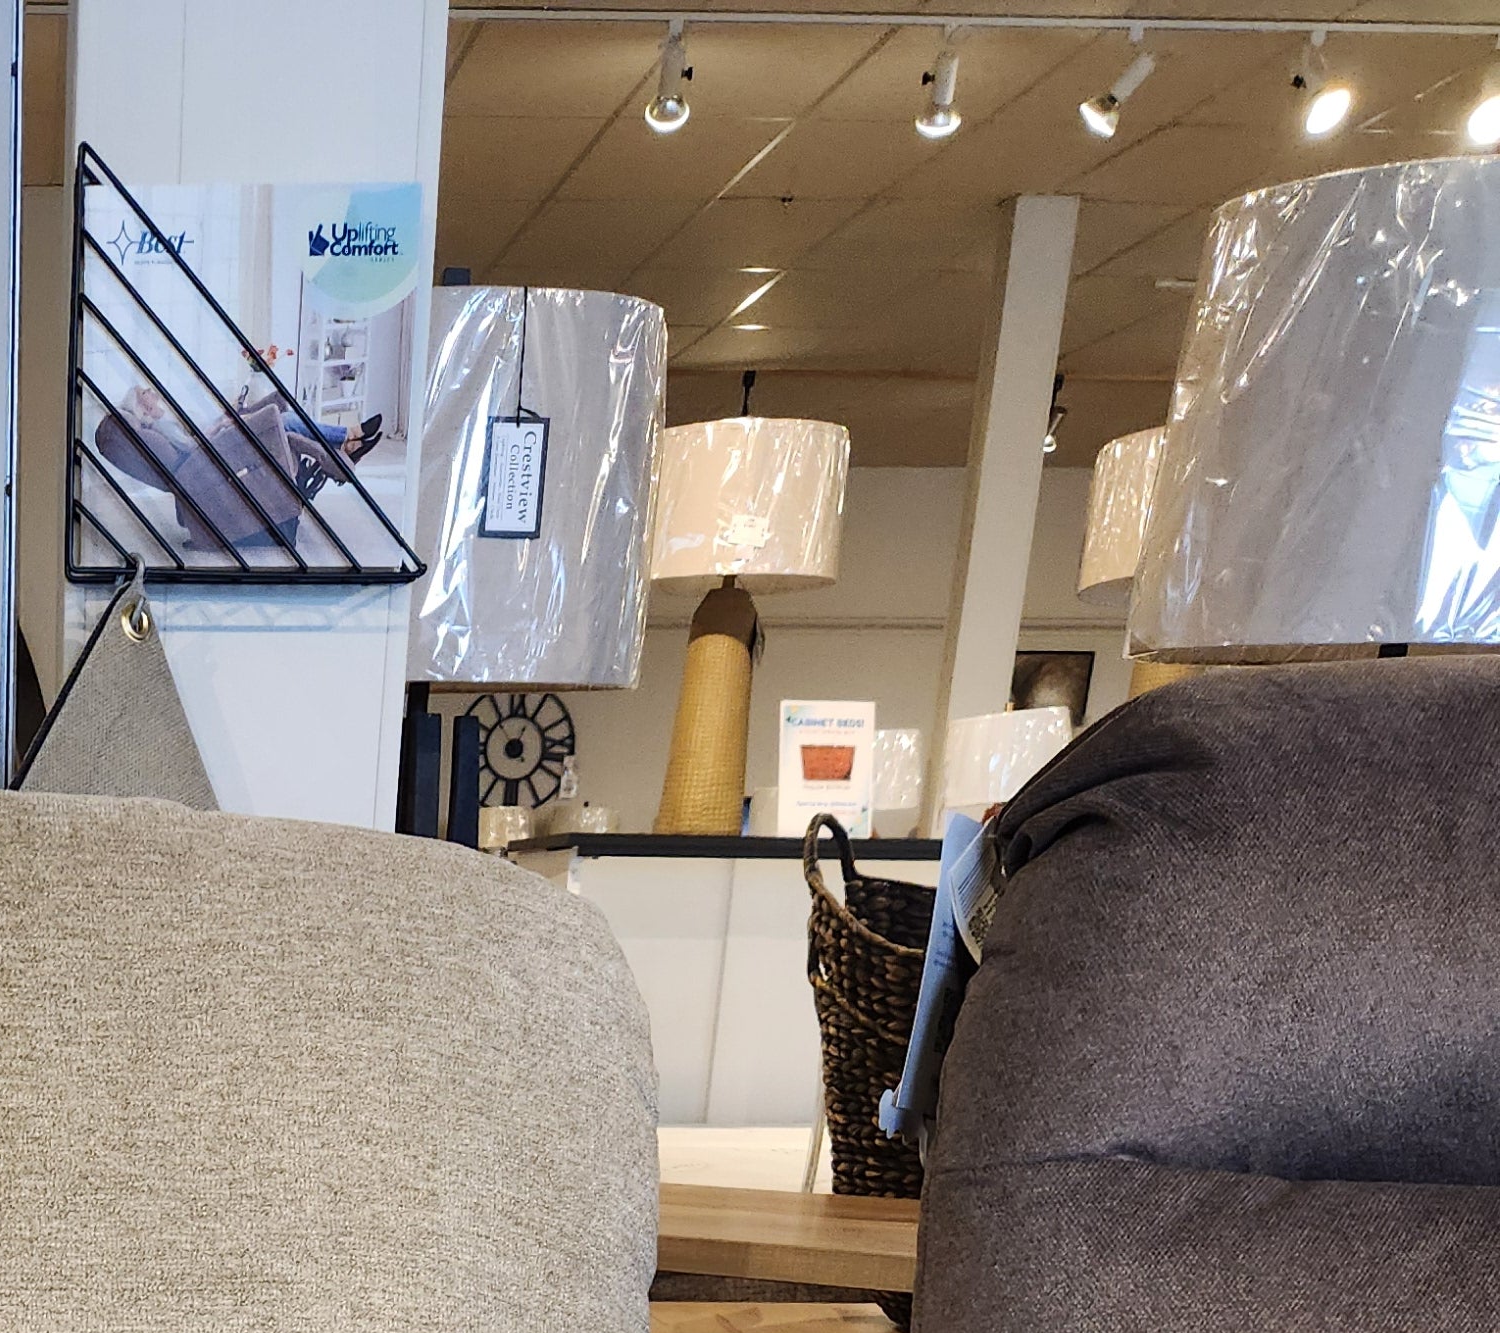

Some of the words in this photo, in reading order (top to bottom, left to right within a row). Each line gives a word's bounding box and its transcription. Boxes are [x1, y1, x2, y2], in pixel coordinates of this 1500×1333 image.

[329, 239, 399, 256] Comfort
[331, 221, 397, 247] Uplifting
[506, 444, 520, 510] Collection
[517, 430, 538, 524] Crestview
